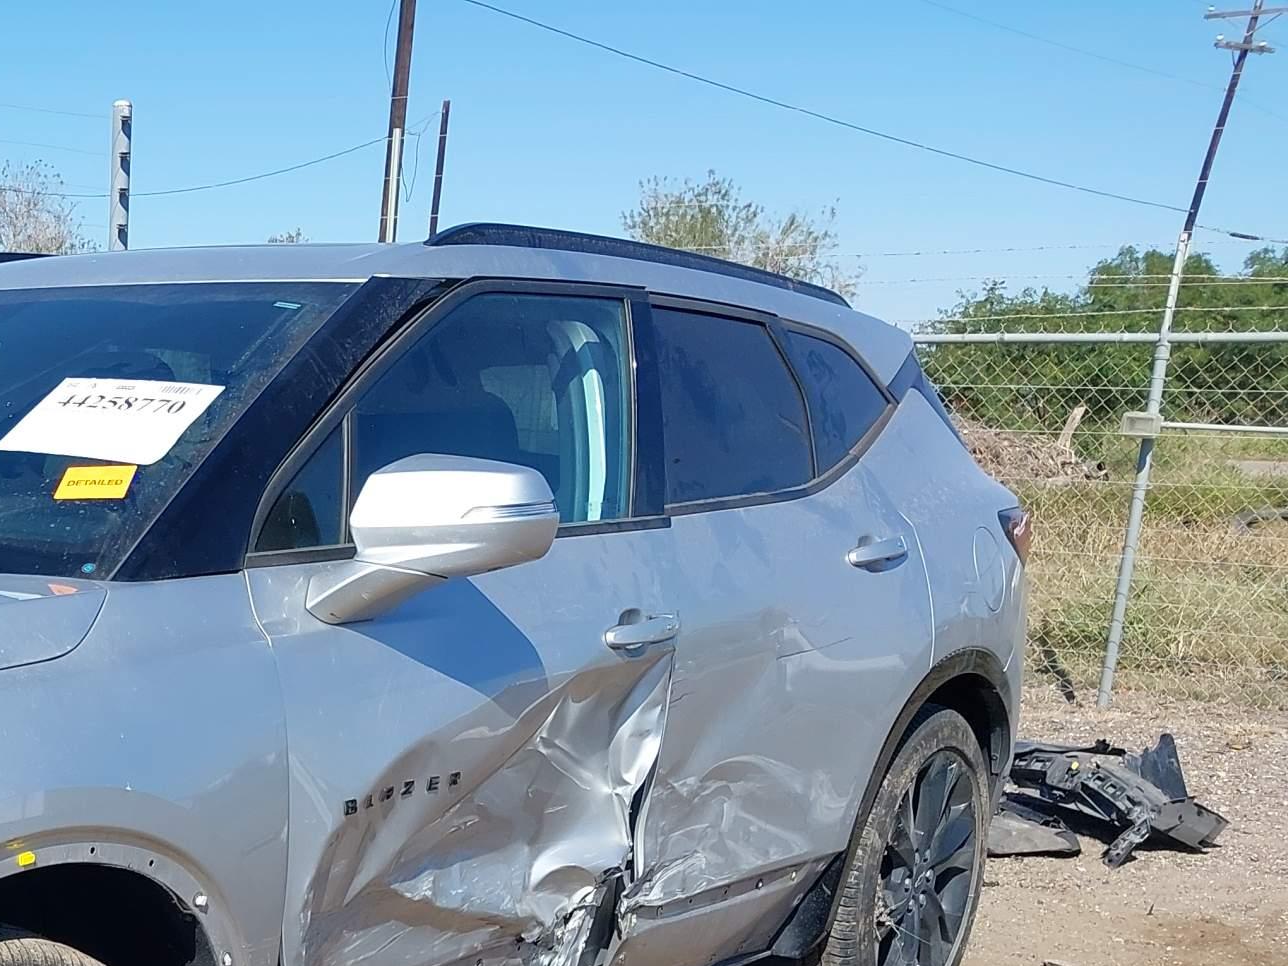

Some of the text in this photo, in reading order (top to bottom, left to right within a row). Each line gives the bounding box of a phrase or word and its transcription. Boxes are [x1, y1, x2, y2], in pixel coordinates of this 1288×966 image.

[57, 394, 186, 414] 44258770
[67, 478, 123, 488] DETAILED
[343, 771, 462, 817] BLAZER
